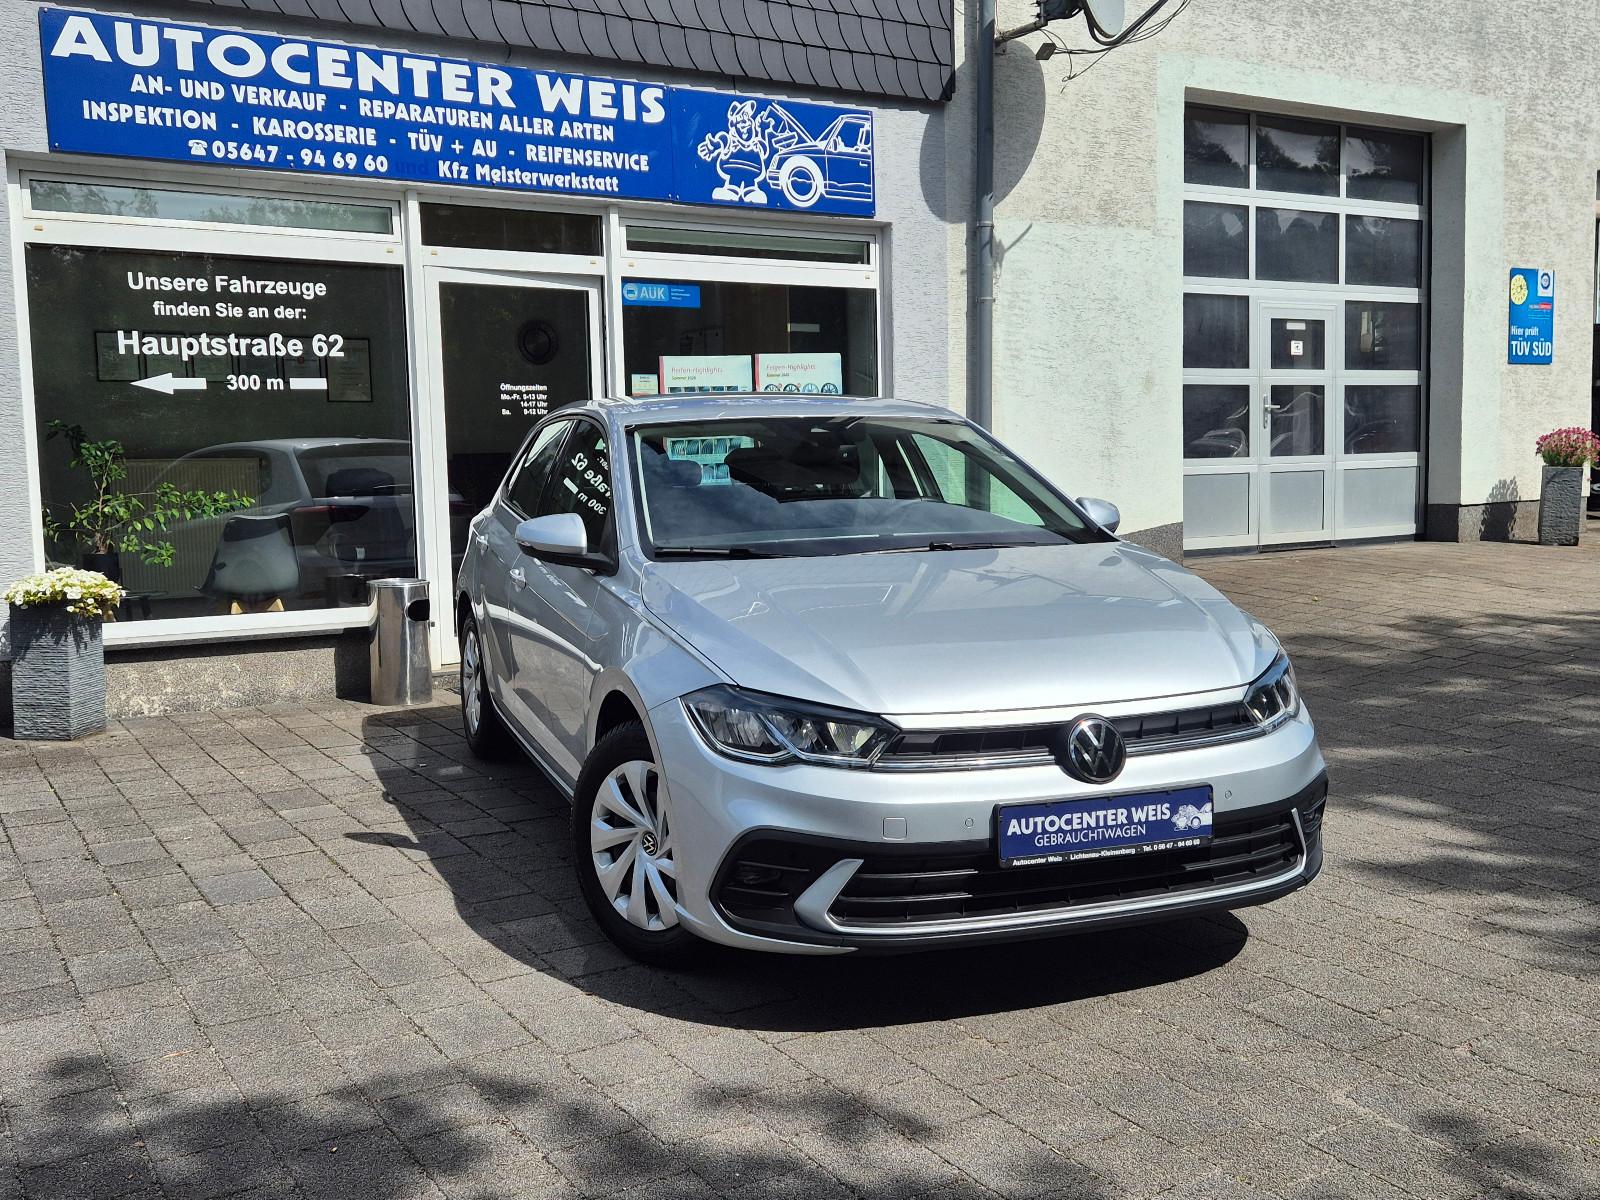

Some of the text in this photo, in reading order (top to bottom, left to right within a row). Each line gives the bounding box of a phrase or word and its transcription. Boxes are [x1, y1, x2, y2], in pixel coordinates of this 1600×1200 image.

[51, 15, 667, 124] AUTOCENTER WEIS
[130, 73, 173, 96] AN-
[180, 78, 225, 101] UND
[231, 83, 327, 112] VERKAUF
[360, 98, 493, 130] REPARATUREN
[499, 113, 554, 138] ALLER
[559, 120, 615, 142] ARTEN
[83, 100, 217, 131] INSPEKTION
[253, 116, 377, 147] KAROSSERIE
[407, 130, 443, 153] TÜV
[472, 138, 497, 157] AU
[526, 143, 649, 172] REIFENSERVICE
[212, 141, 278, 163] 05647
[300, 148, 326, 168] 94
[332, 151, 357, 170] 69
[363, 153, 388, 172] 60
[438, 160, 468, 180] Kfz
[475, 161, 619, 192] Meisterwerkstatt
[128, 271, 327, 300] Unsere Fahrzeuge
[153, 301, 308, 320] finden Sie an der:
[117, 330, 345, 361] Hauptstraße 62
[1511, 325, 1524, 336] Hier
[1511, 337, 1552, 357] TÜV SÜD
[227, 374, 284, 391] 300 m
[1007, 803, 1171, 836] AUTOCENTER WEIS
[1034, 823, 1146, 847] GEBRAUCHTWAGEN
